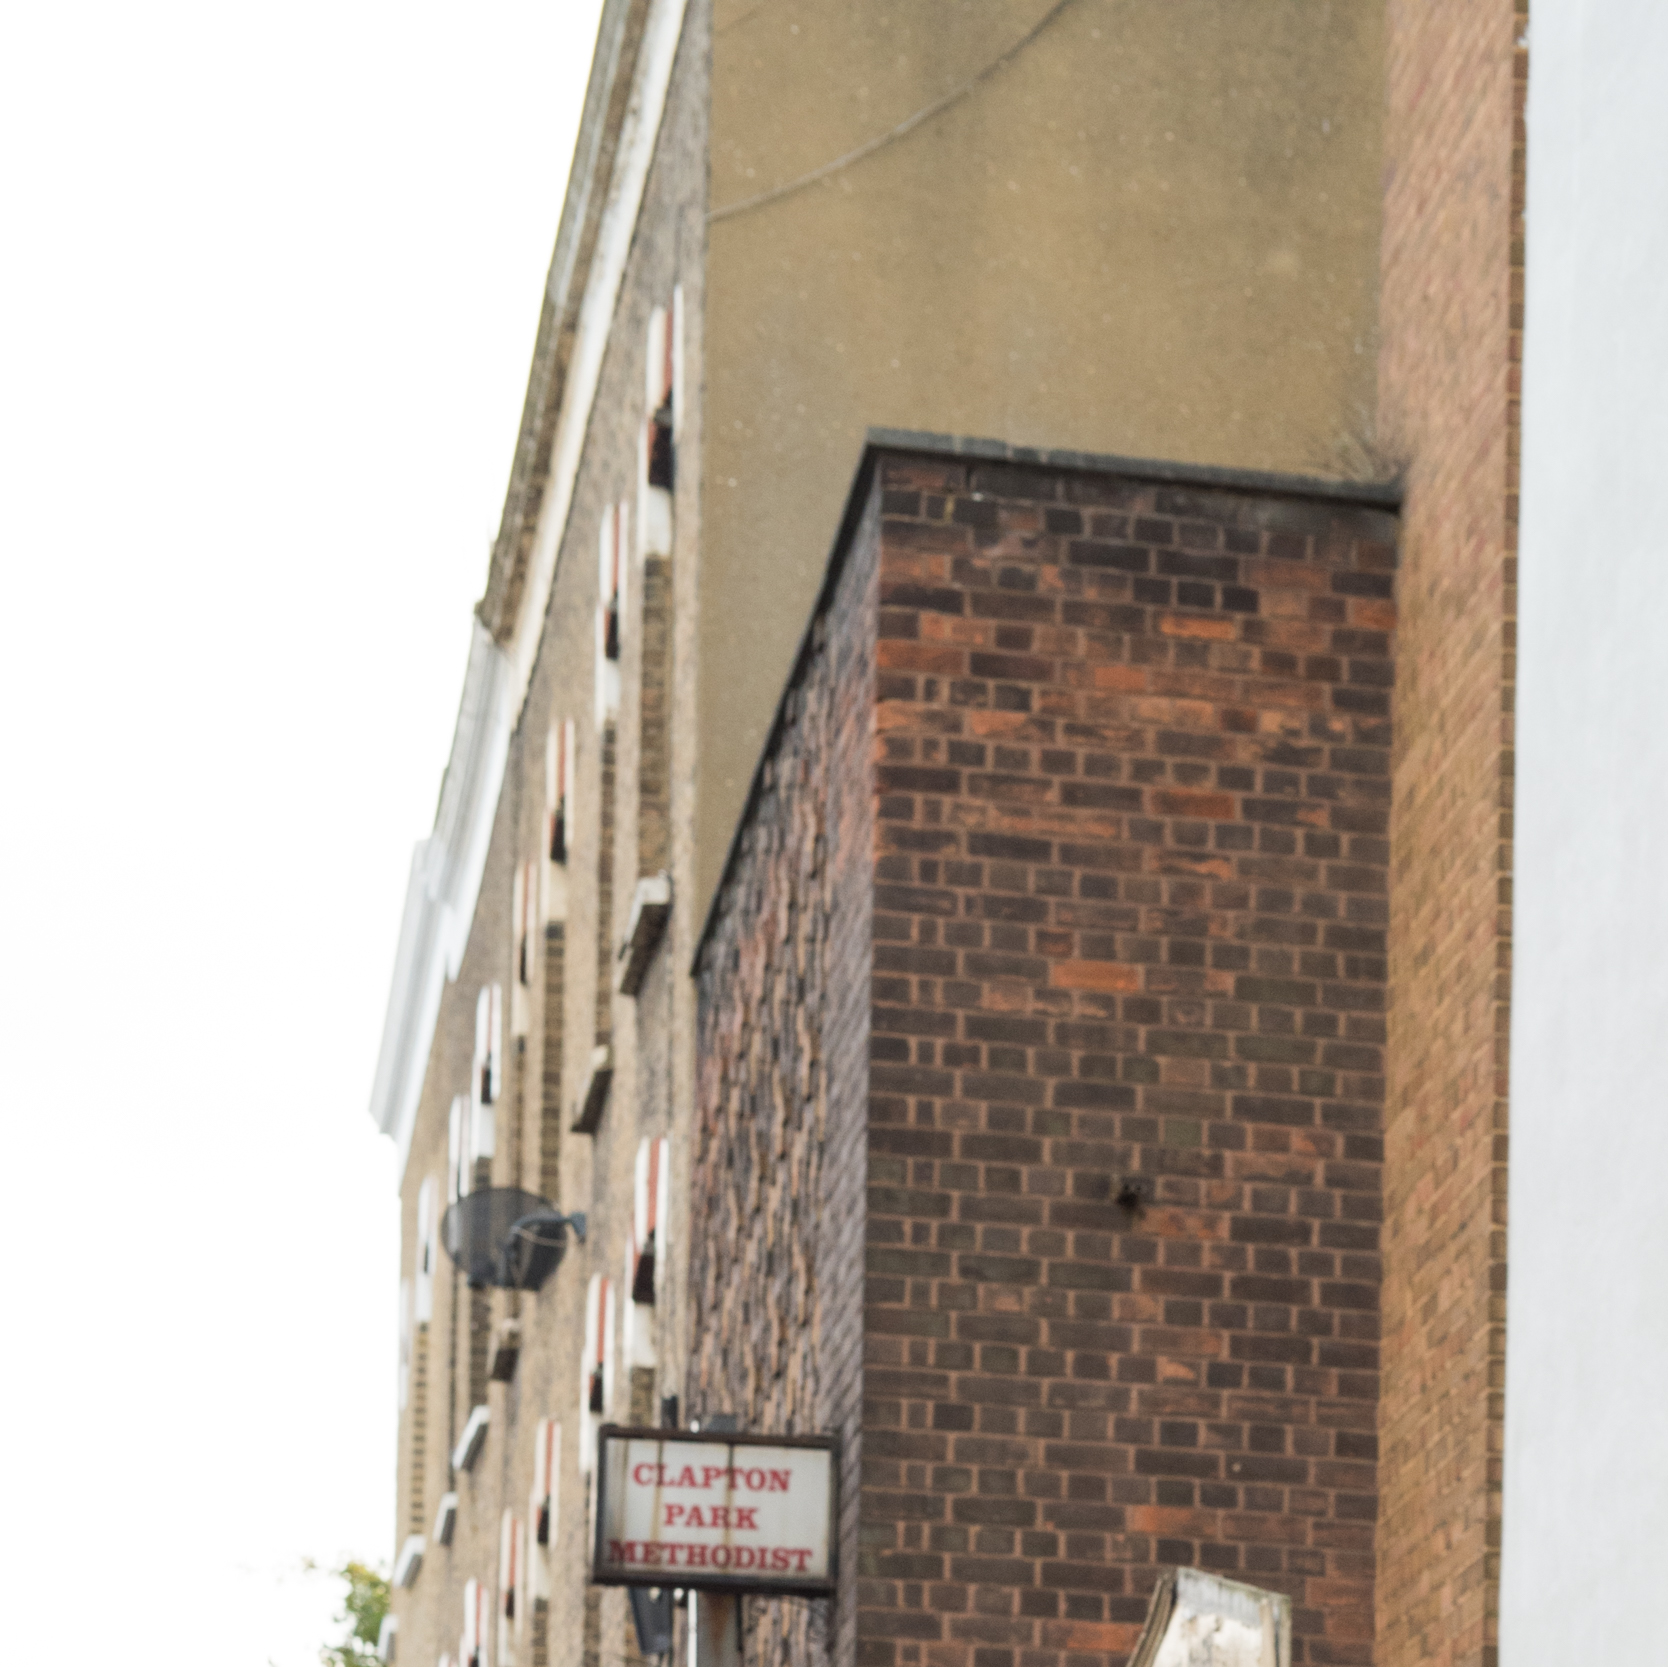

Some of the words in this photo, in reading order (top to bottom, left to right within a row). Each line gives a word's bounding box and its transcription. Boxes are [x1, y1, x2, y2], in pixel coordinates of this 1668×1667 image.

[633, 1462, 792, 1492] CLAPTON
[664, 1504, 760, 1530] PARK
[608, 1538, 814, 1572] METHODIST
